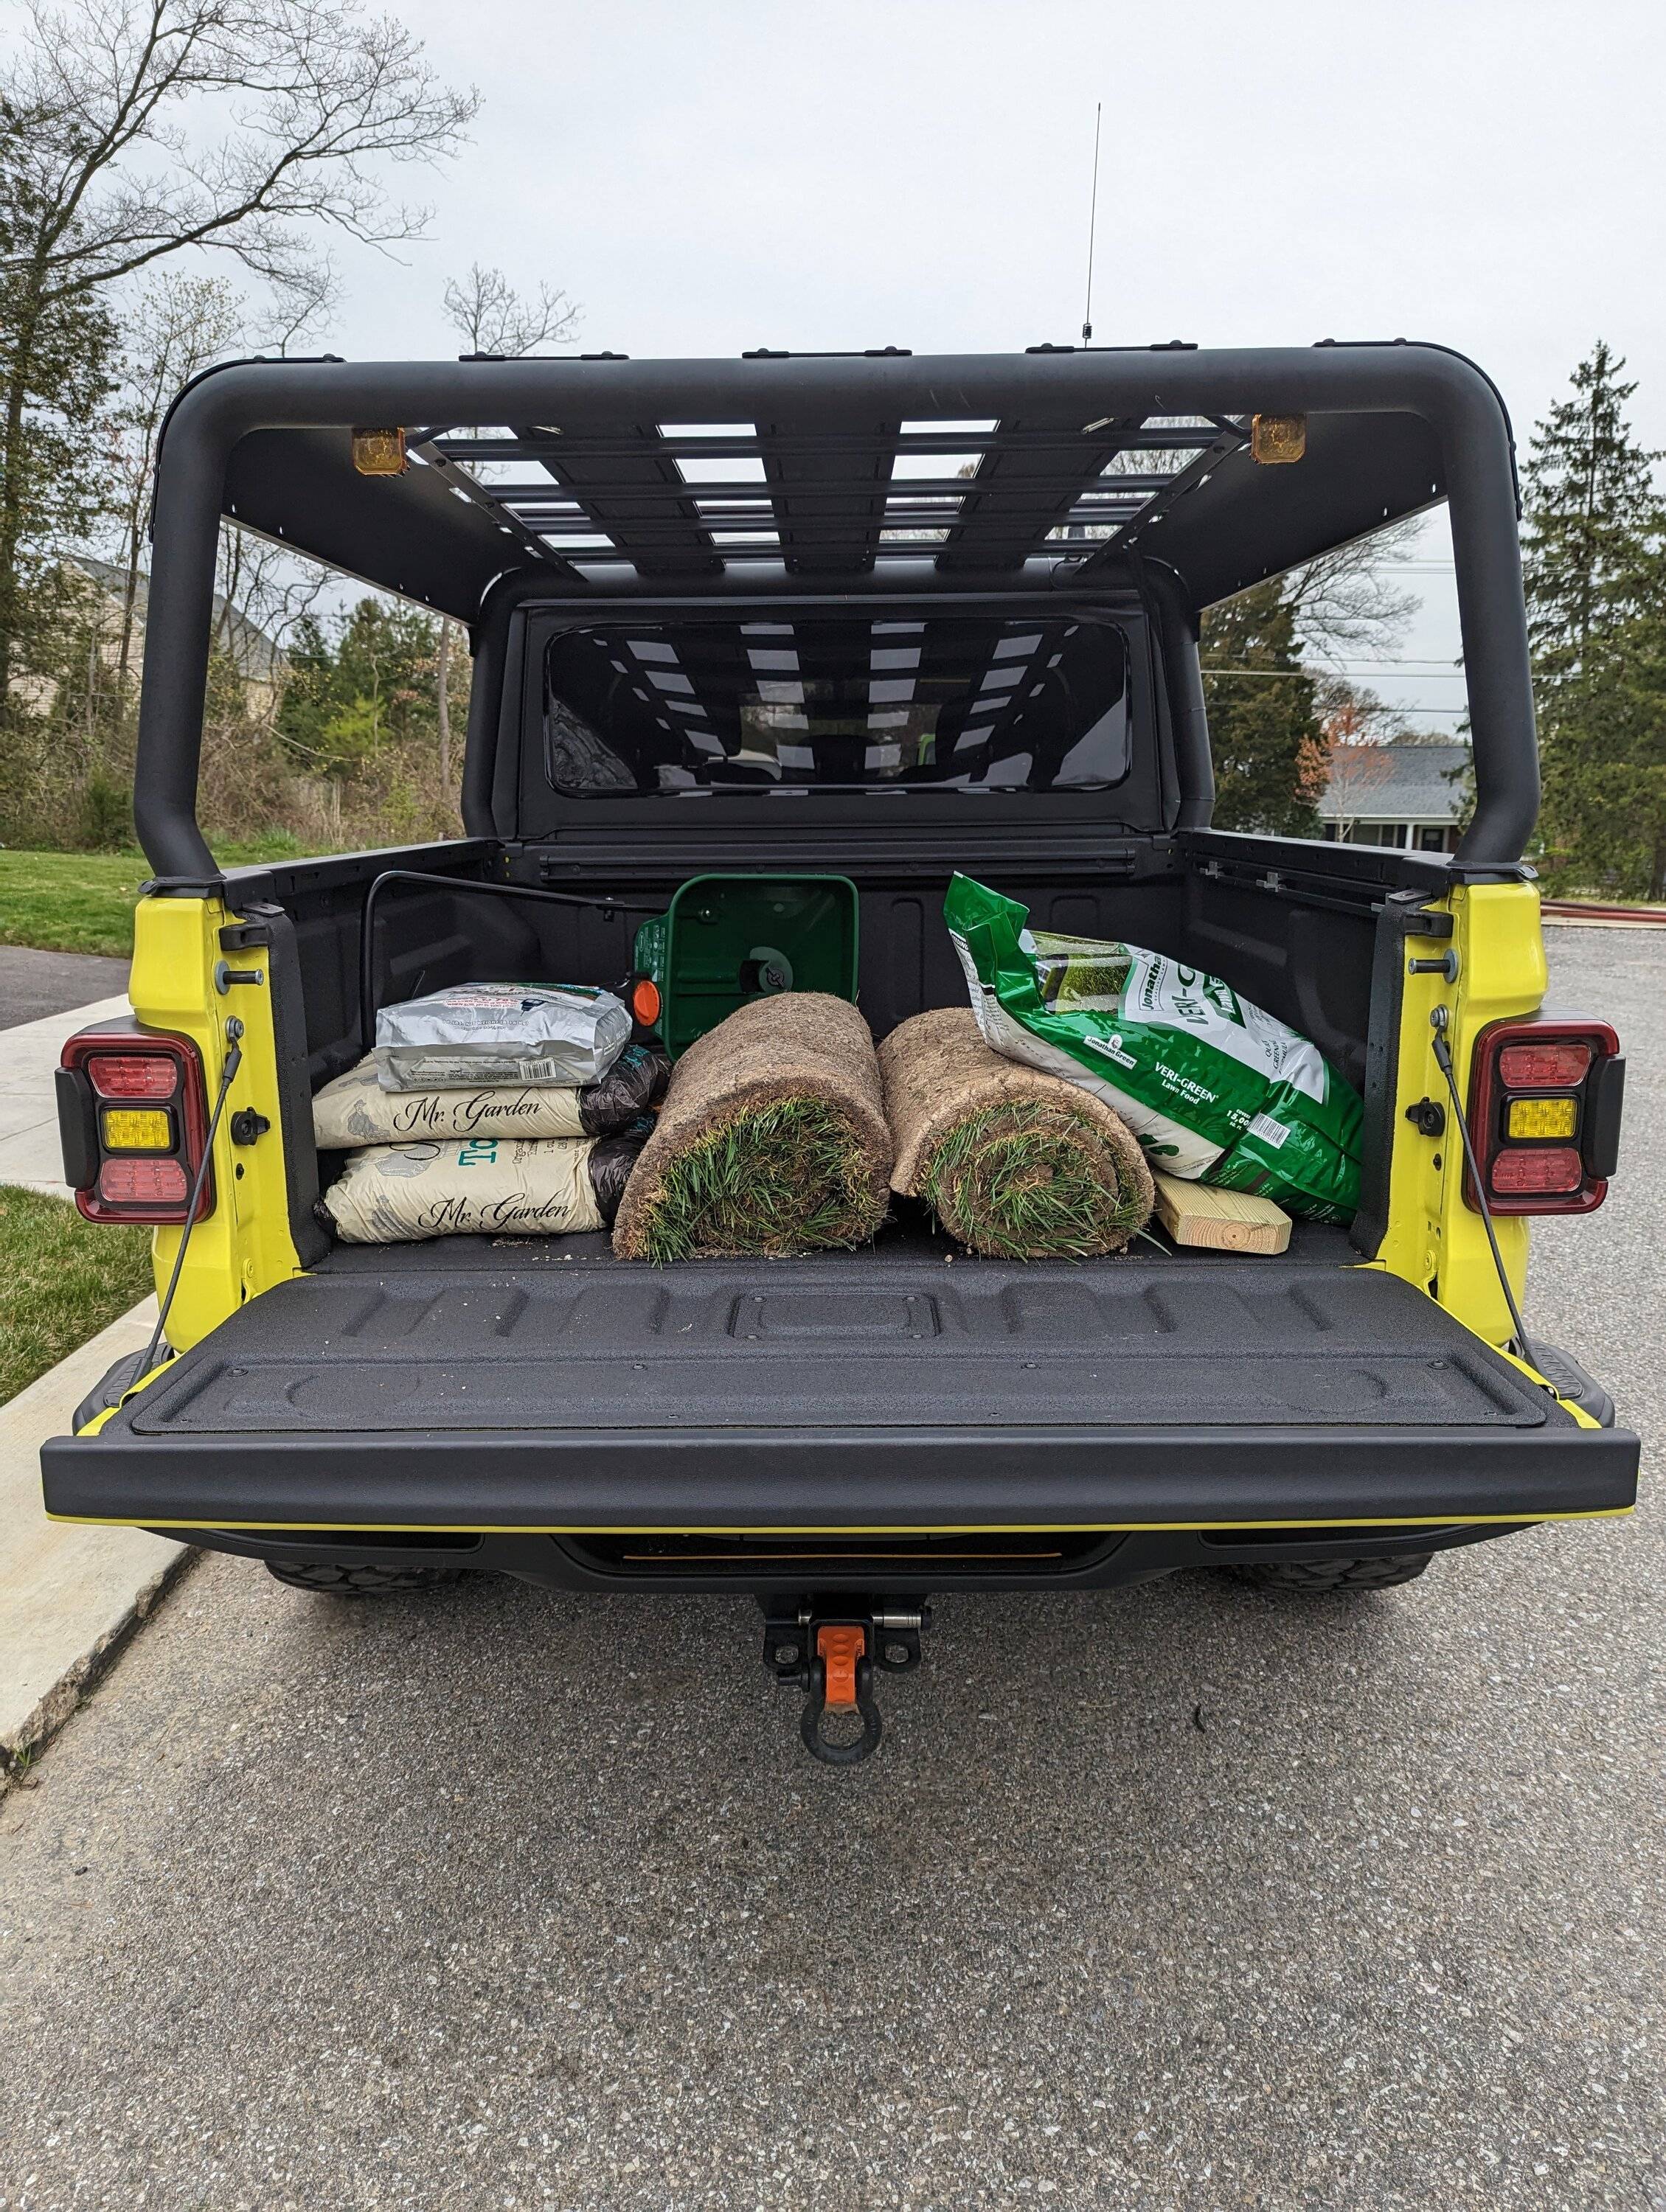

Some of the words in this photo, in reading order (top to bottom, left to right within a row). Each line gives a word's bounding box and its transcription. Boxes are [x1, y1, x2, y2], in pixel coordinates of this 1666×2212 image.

[1142, 956, 1162, 1010] Jonatha
[1087, 1037, 1116, 1054] Jonathan
[1115, 1051, 1135, 1065] Green
[1162, 1079, 1180, 1094] Lawn
[1179, 1088, 1201, 1105] Food
[393, 1096, 445, 1132] Mr.
[453, 1087, 542, 1132] Garden
[1226, 1110, 1252, 1127] 15,00
[1236, 1109, 1252, 1119] COVERS
[512, 1139, 526, 1164] Organi
[417, 1197, 472, 1228] Mr.
[479, 1188, 572, 1231] Garden
